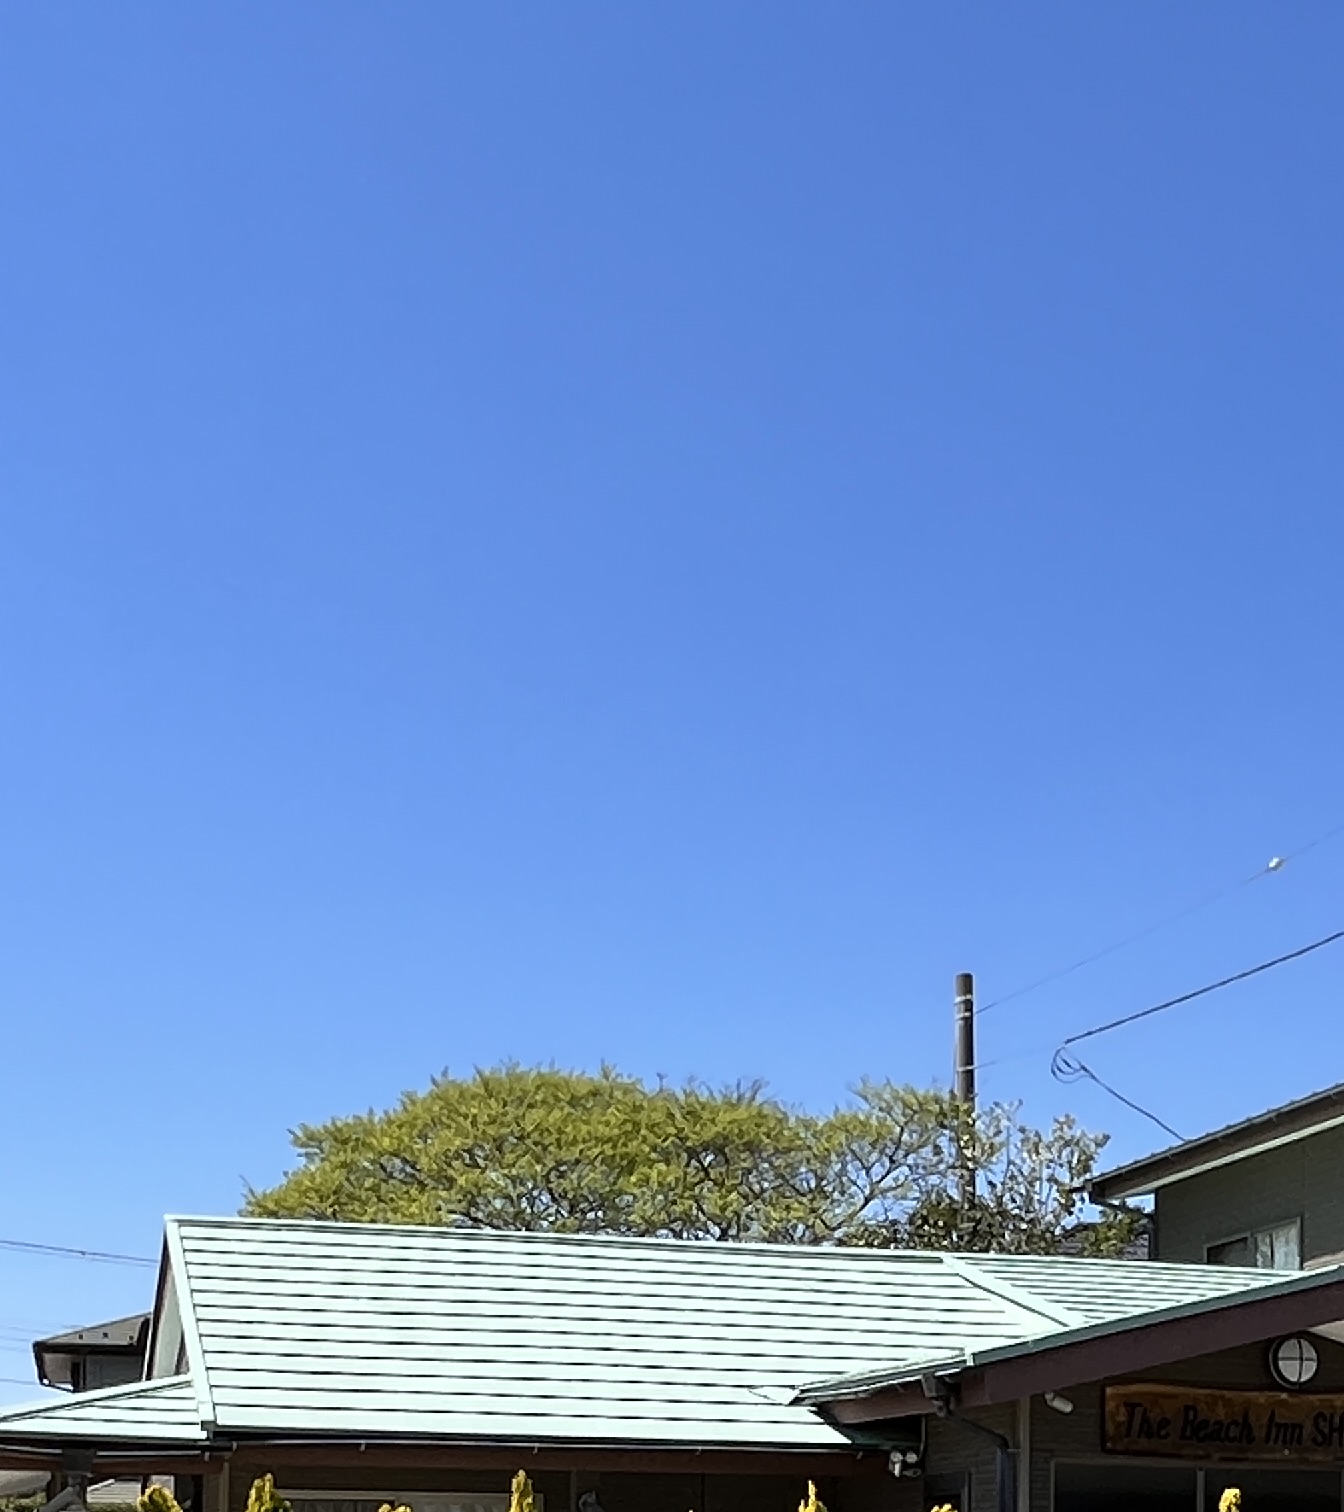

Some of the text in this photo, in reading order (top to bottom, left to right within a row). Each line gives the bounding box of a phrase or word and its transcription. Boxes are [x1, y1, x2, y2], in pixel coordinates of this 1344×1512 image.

[1122, 1402, 1170, 1440] The
[1180, 1404, 1255, 1445] Beach
[1264, 1409, 1304, 1446] Inn
